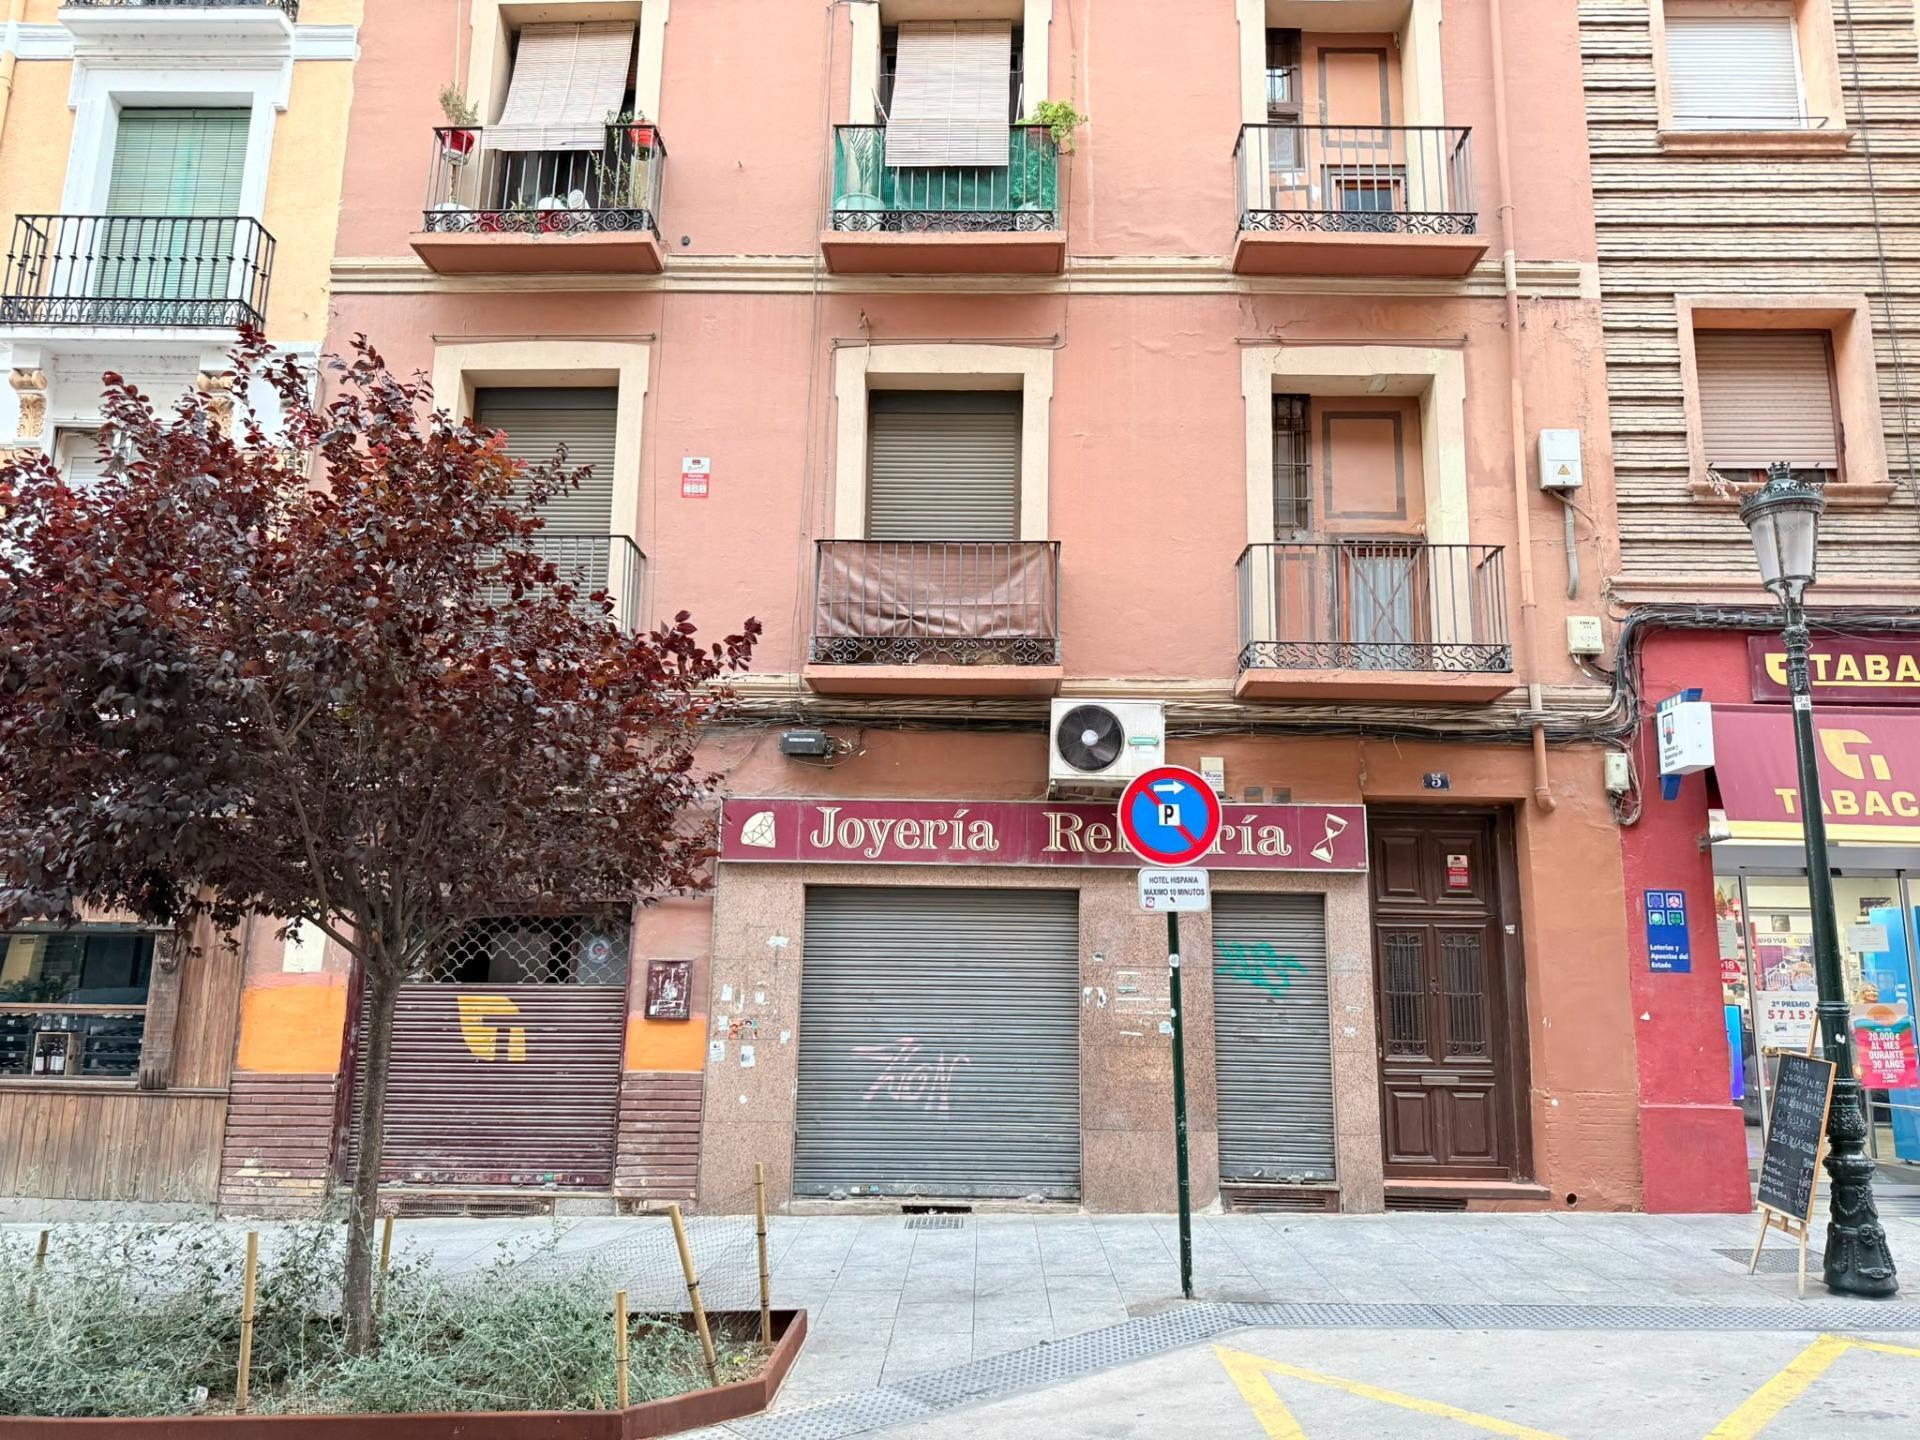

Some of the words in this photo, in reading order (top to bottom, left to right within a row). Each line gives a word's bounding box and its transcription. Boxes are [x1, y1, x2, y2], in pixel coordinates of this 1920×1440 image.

[1774, 788, 1920, 817] TBAC
[1164, 804, 1175, 825] P
[810, 806, 1000, 859] Joyería
[1149, 876, 1169, 884] HOTEL
[1169, 888, 1177, 896] 10
[1177, 888, 1206, 896] MINUTOS
[1650, 952, 1678, 960] Apuestas
[1651, 961, 1672, 969] Estado
[1781, 1000, 1811, 1008] PREMIO
[1871, 1040, 1881, 1050] AL
[1883, 1040, 1900, 1050] MES
[1868, 1050, 1905, 1060] DURANTE
[1872, 1060, 1883, 1069] 30
